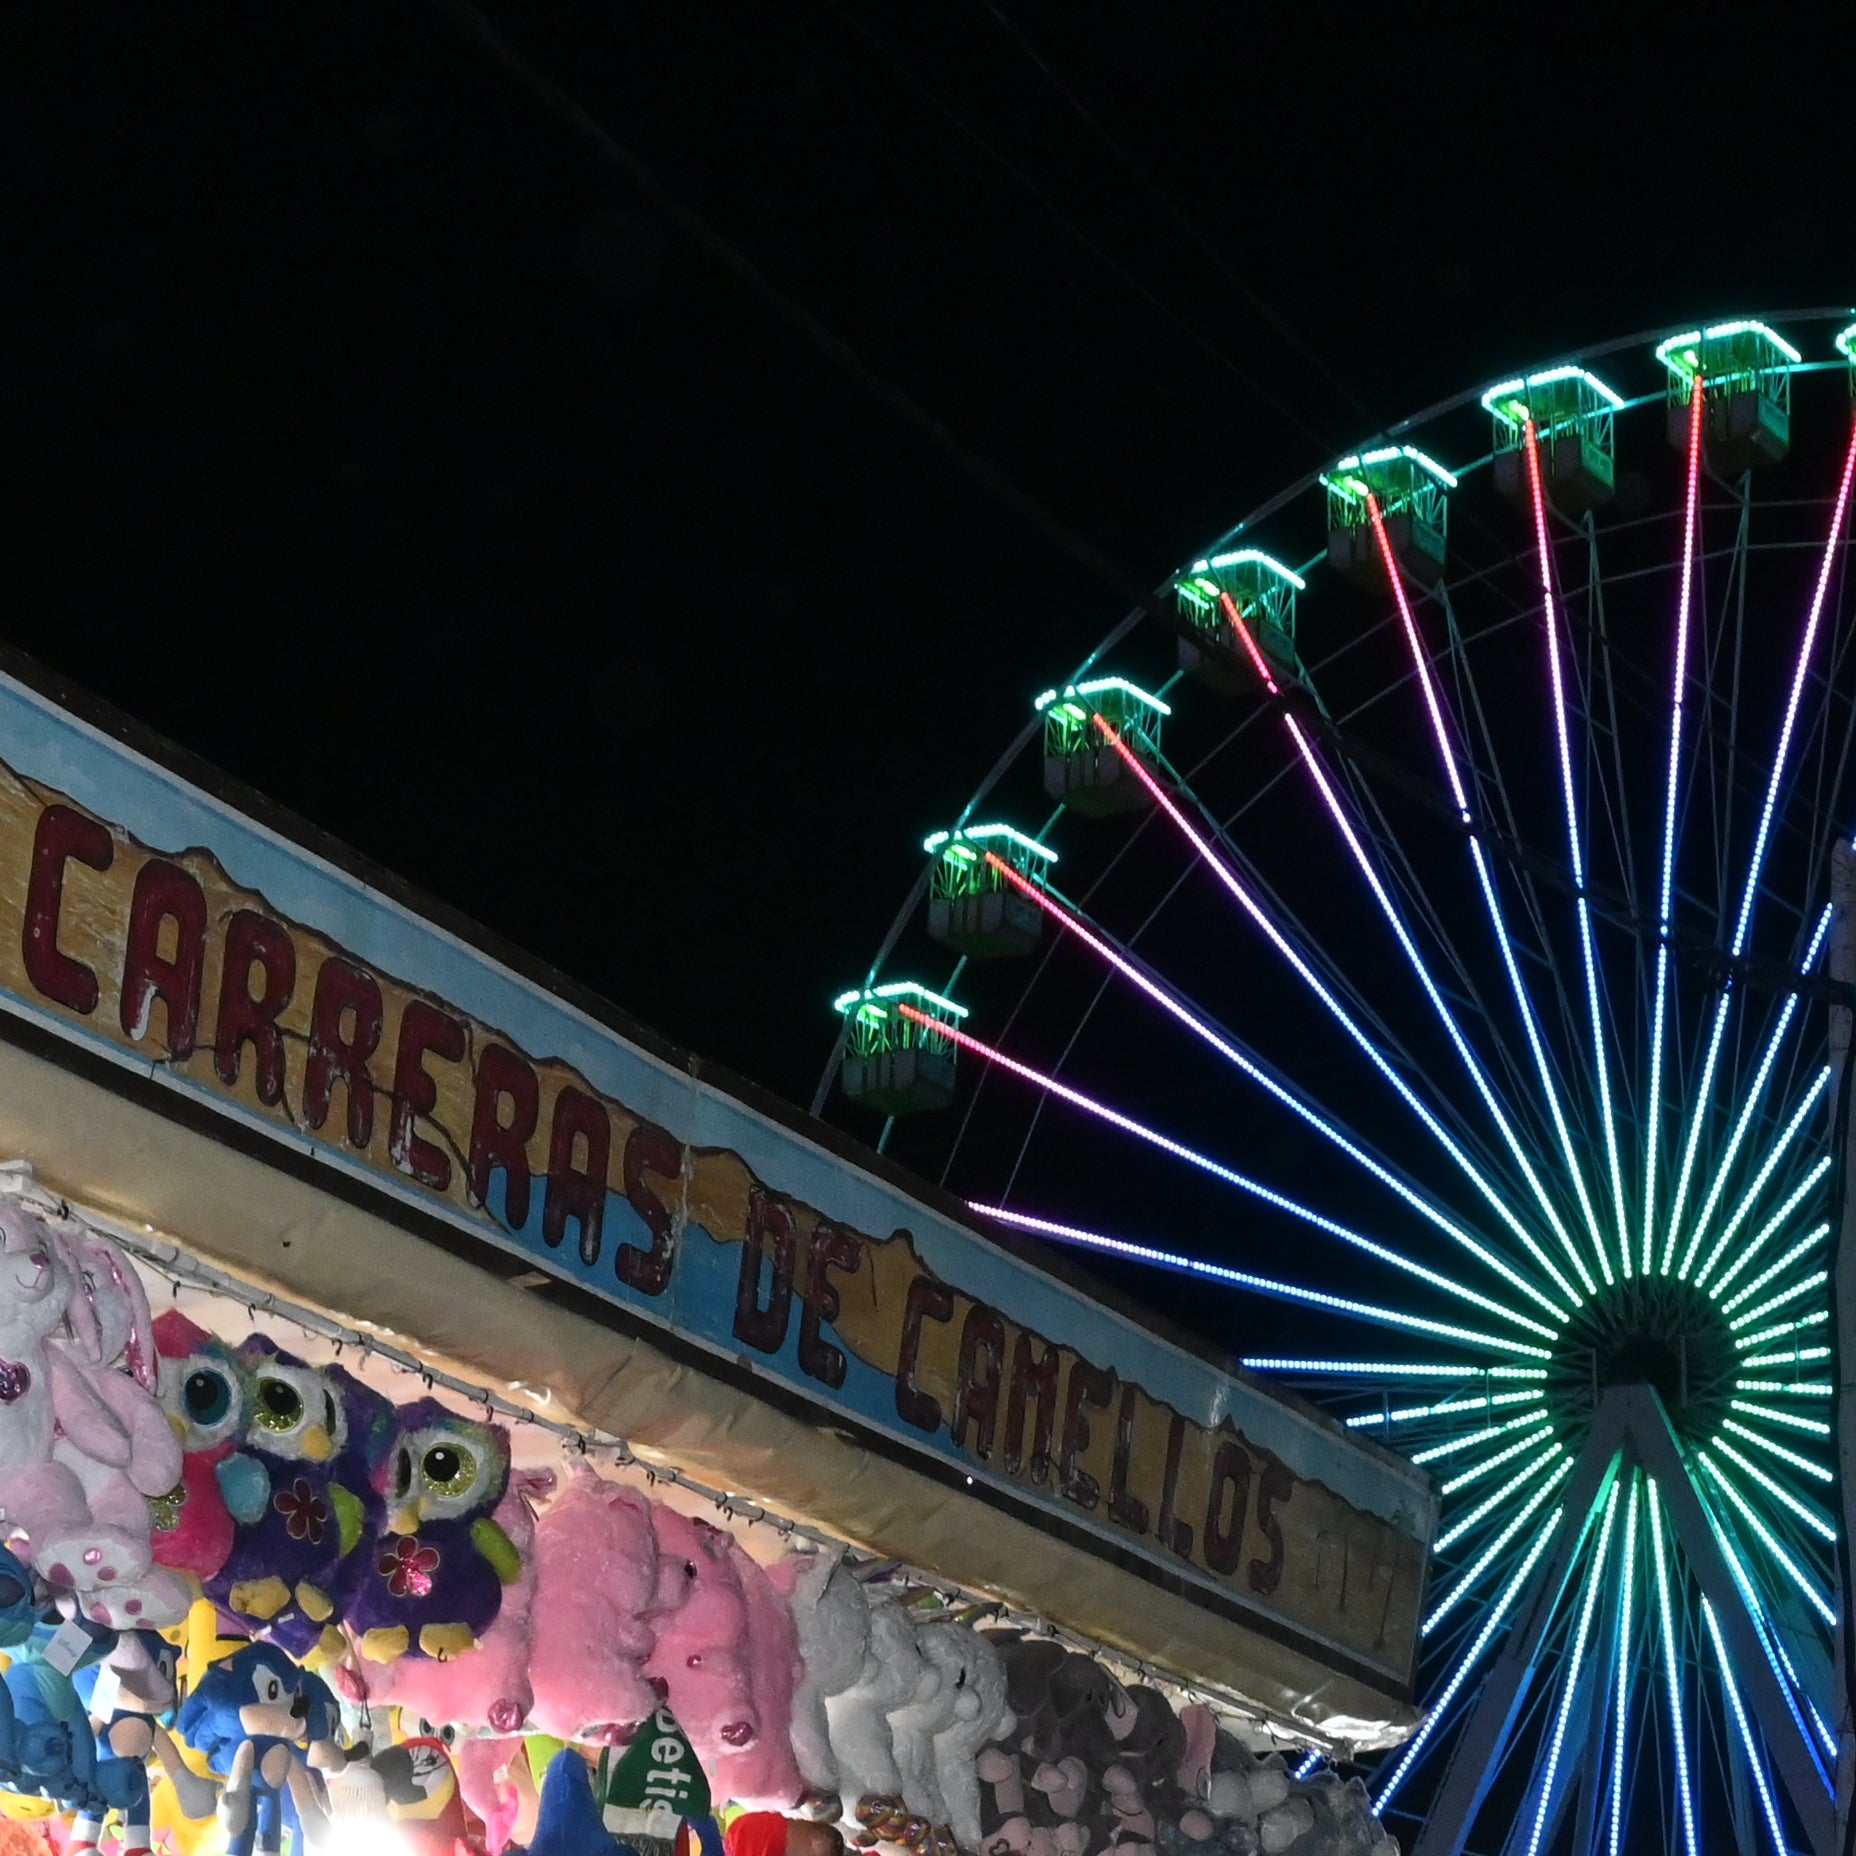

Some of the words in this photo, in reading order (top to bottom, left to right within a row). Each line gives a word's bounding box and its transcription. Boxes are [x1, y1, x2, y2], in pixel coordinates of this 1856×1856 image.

[21, 803, 686, 1298] CARRERAS
[733, 1184, 861, 1389] DE
[894, 1280, 1293, 1596] CAMELLOS
